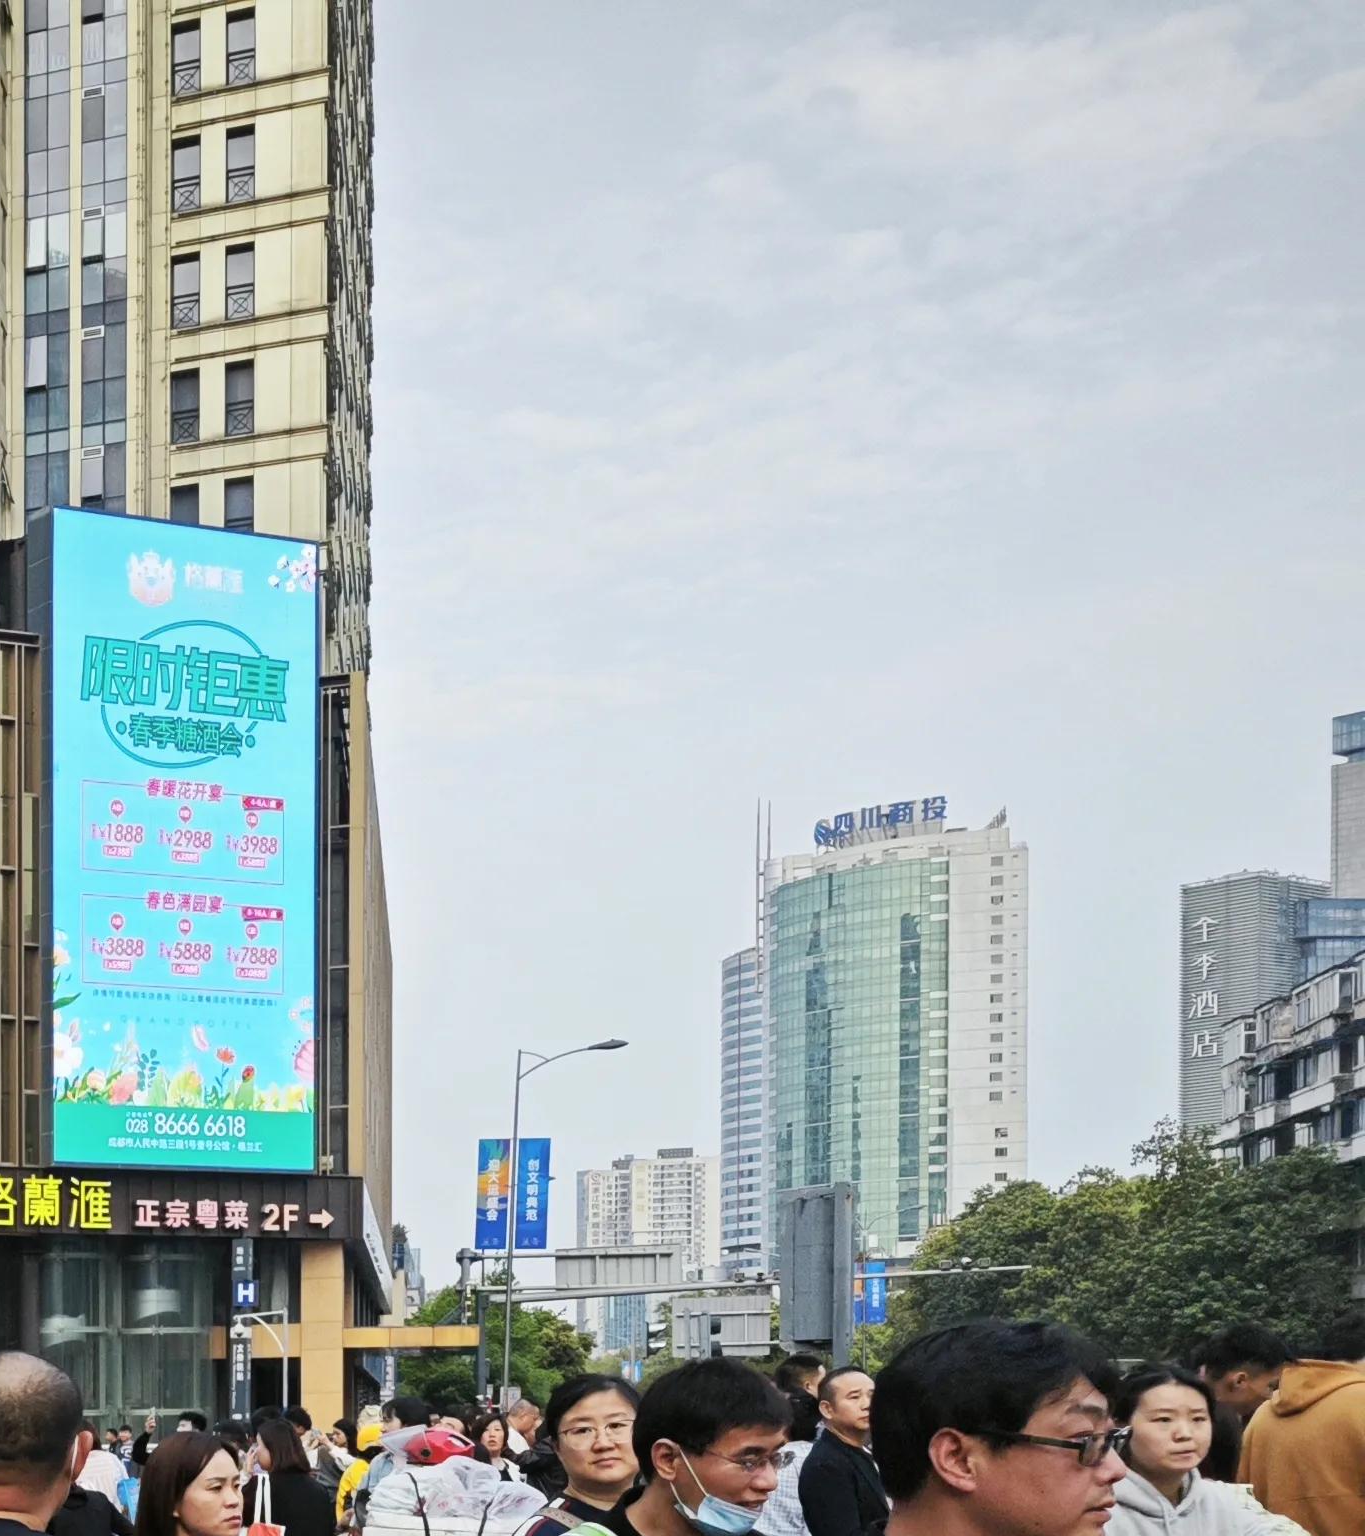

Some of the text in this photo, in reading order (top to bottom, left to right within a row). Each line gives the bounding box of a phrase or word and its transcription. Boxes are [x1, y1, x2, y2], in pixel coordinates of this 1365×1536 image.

[80, 634, 290, 722] 限时钜惠
[128, 712, 244, 758] 春季糖酒会
[833, 795, 949, 837] 四川商投
[125, 1112, 246, 1138] 028 8666 6618
[525, 1157, 540, 1222] 创文明典范
[135, 1199, 300, 1232] 正宗粤菜 2F
[237, 1282, 254, 1303] H
